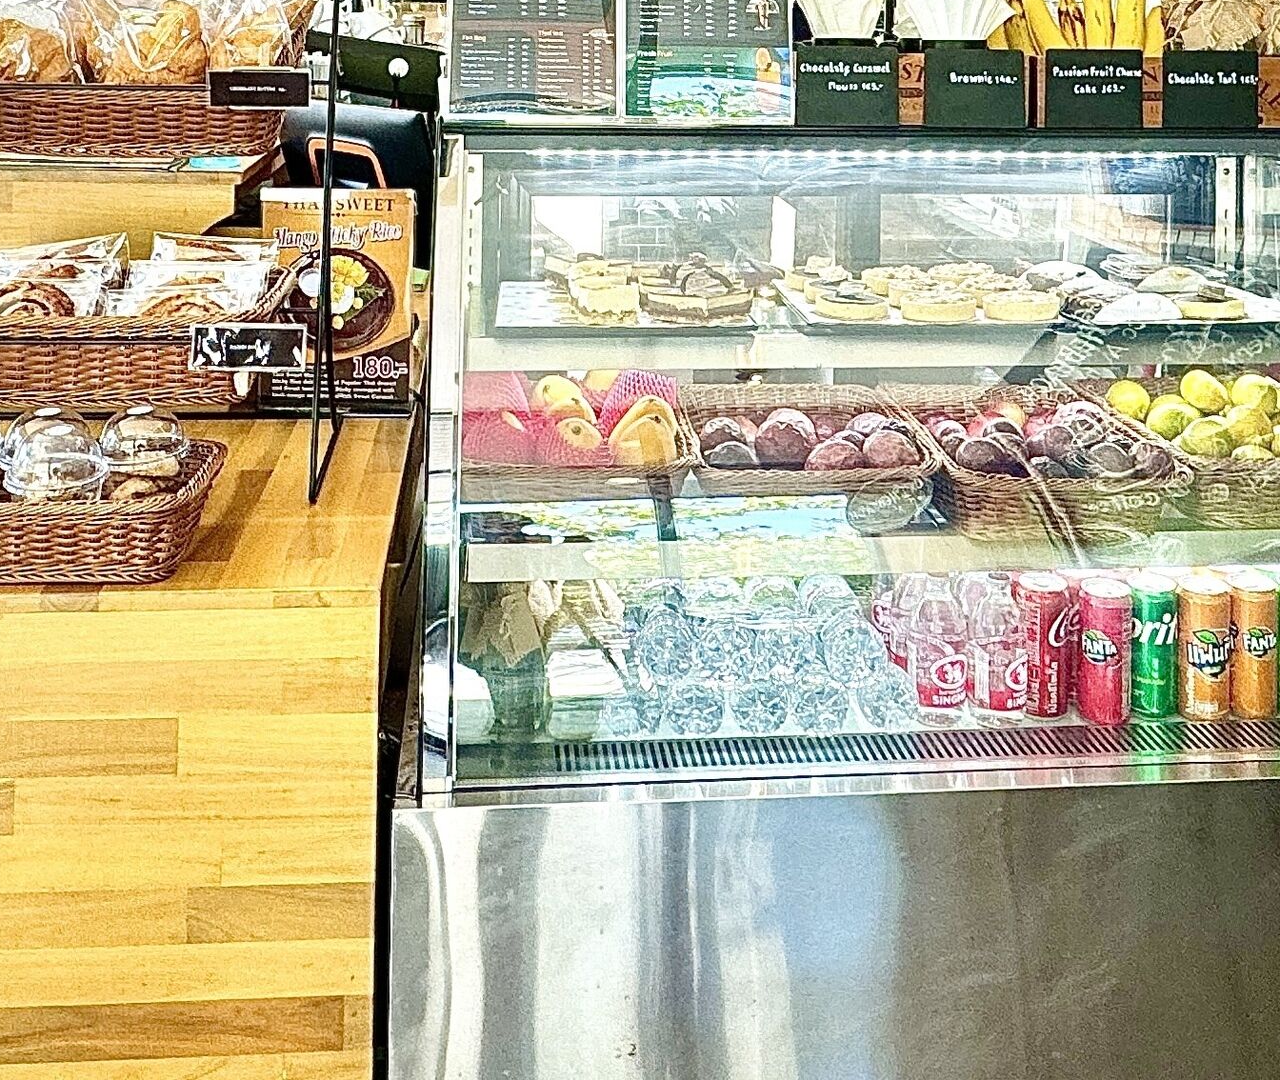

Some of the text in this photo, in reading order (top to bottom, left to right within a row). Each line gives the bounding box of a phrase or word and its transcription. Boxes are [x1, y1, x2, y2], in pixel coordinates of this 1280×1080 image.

[949, 70, 993, 85] Brownie
[1052, 64, 1089, 78] Passion
[1090, 64, 1114, 78] Fruit
[1167, 72, 1215, 85] Chocolate
[1218, 71, 1237, 85] Tart
[1073, 84, 1097, 94] Cake
[335, 197, 396, 212] SWEET
[368, 221, 403, 242] Rice
